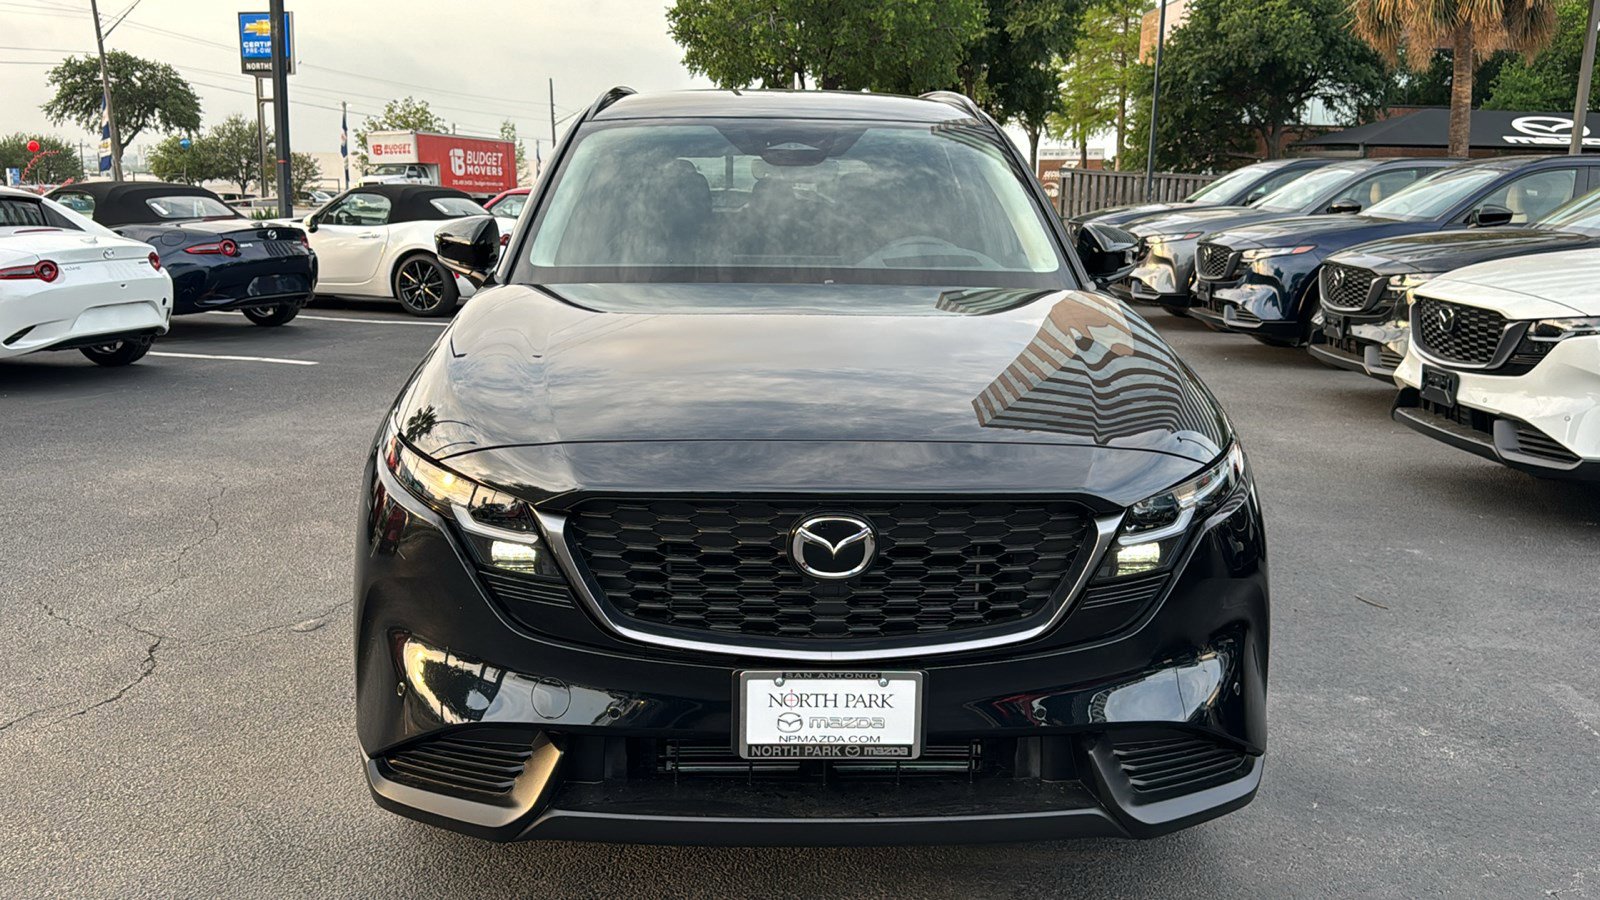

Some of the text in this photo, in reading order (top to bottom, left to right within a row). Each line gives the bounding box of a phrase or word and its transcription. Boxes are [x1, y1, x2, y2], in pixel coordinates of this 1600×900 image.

[466, 151, 503, 166] BUDGET
[467, 165, 503, 176] MOVERS
[768, 691, 895, 709] NORTH PARK
[808, 716, 885, 729] mazda
[778, 735, 881, 743] NPMAZDA.COM
[751, 746, 908, 757] NORTH PARK mazda
